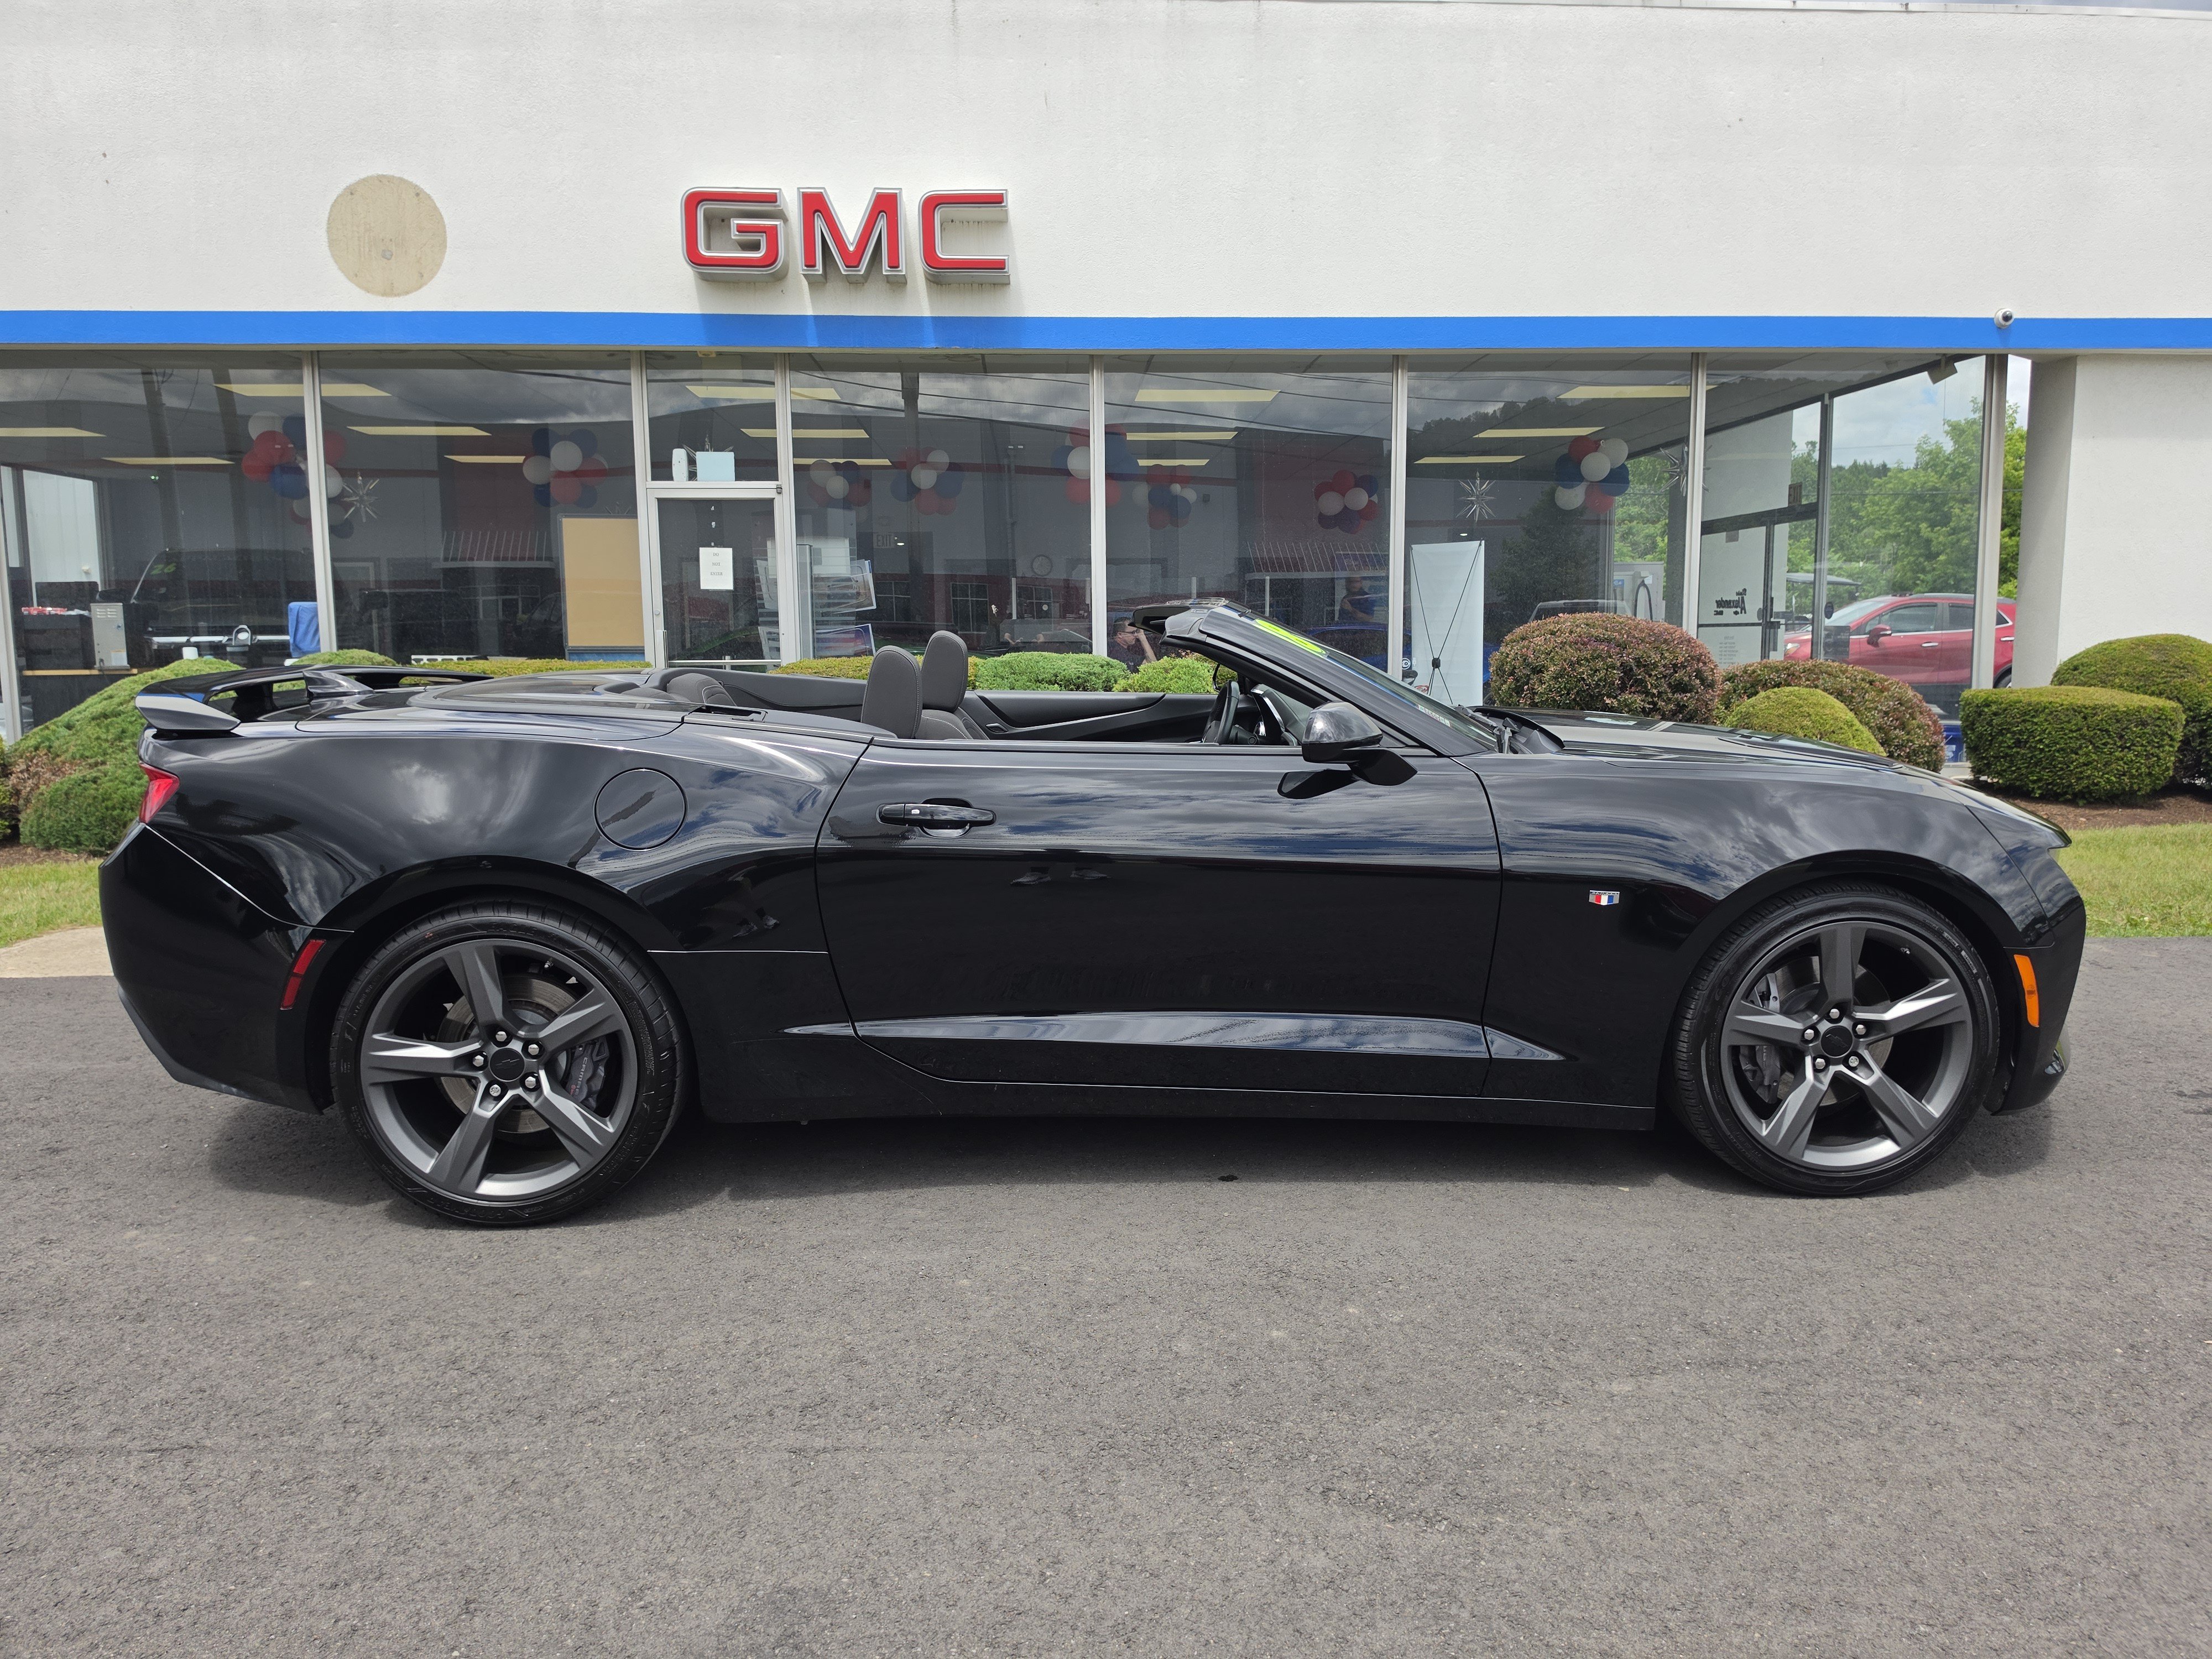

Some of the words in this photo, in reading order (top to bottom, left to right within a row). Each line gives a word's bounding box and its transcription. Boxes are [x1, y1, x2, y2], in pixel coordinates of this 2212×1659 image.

[681, 186, 1010, 275] GMC
[876, 534, 892, 547] EXIT
[575, 1057, 588, 1096] CAMAR
